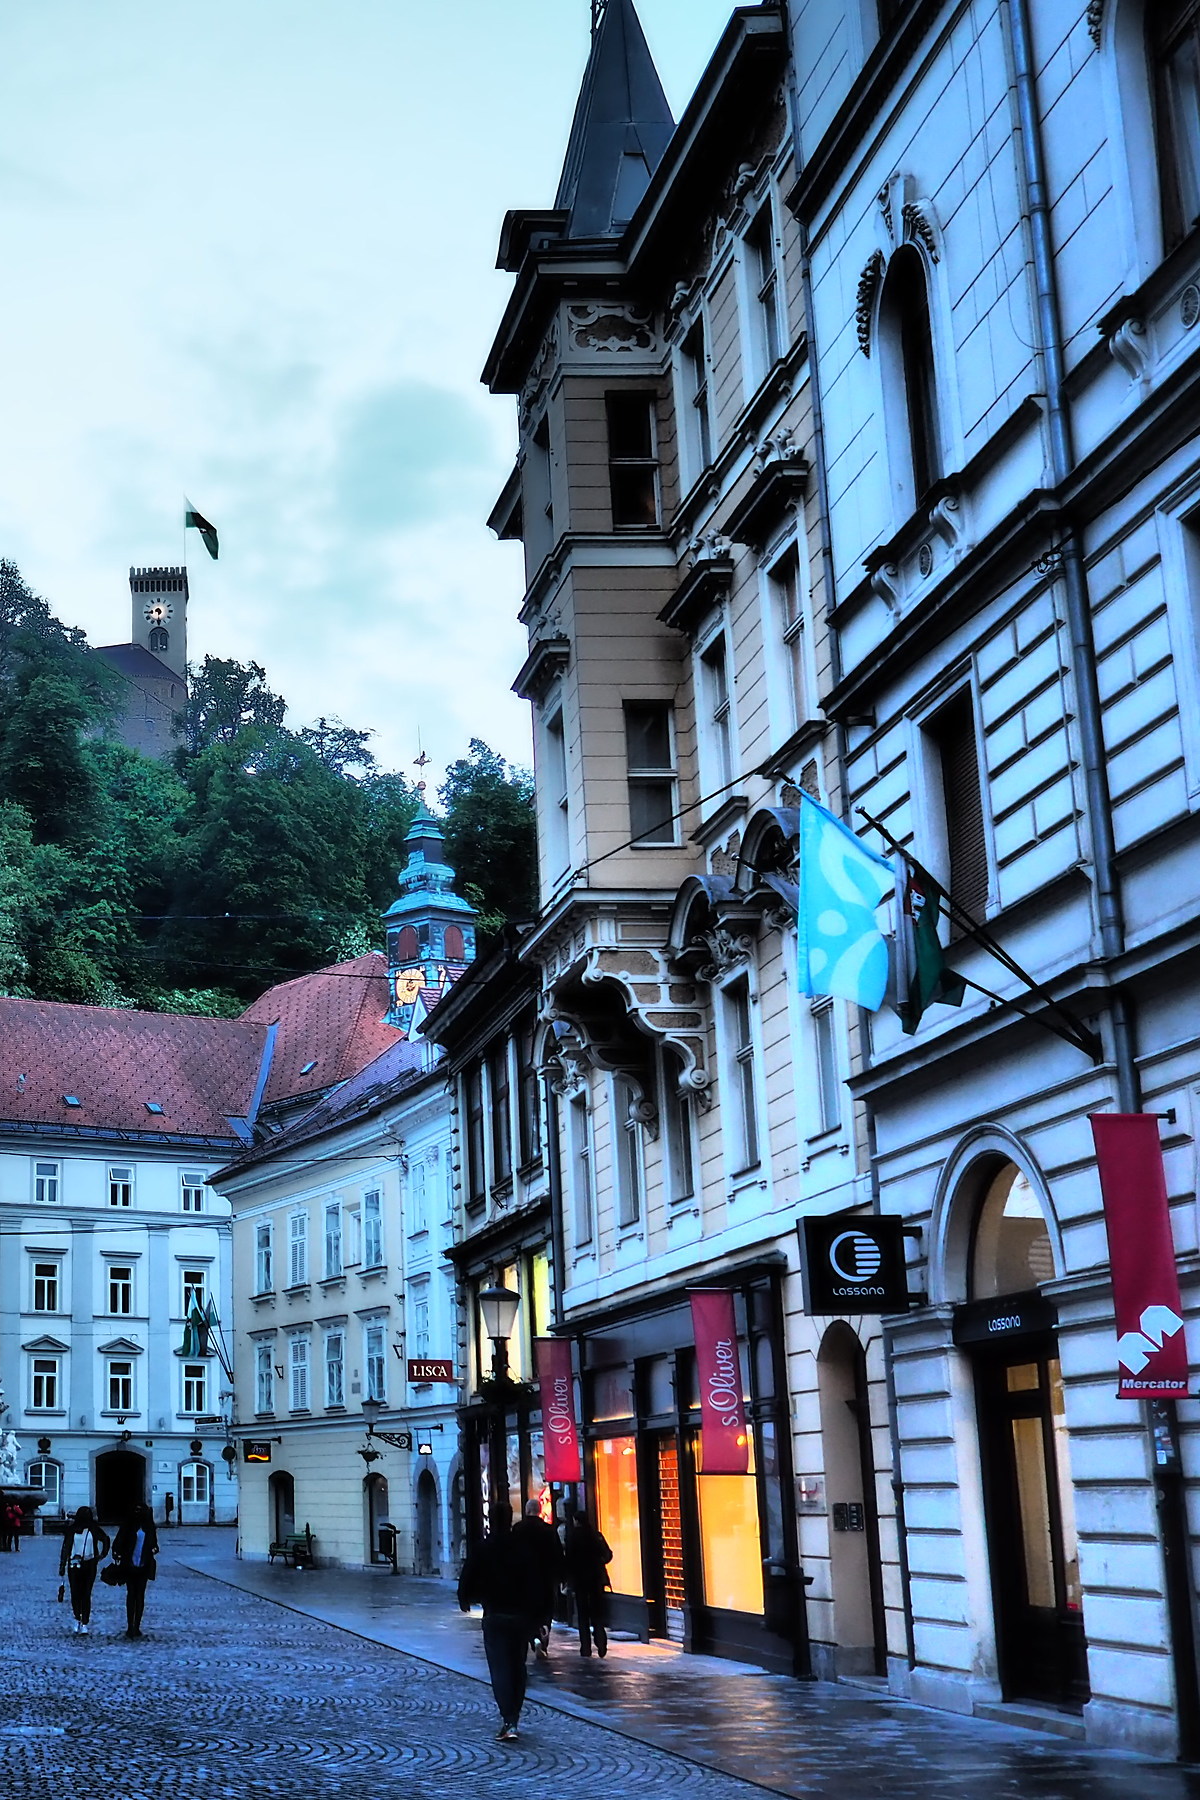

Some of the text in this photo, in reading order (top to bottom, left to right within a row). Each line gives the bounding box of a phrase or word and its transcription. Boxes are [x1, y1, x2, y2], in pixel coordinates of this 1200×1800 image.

[413, 1365, 448, 1377] LISCA
[708, 1338, 739, 1427] s.Oliver
[1121, 1379, 1186, 1389] Mercator
[548, 1376, 572, 1445] s.Oliver
